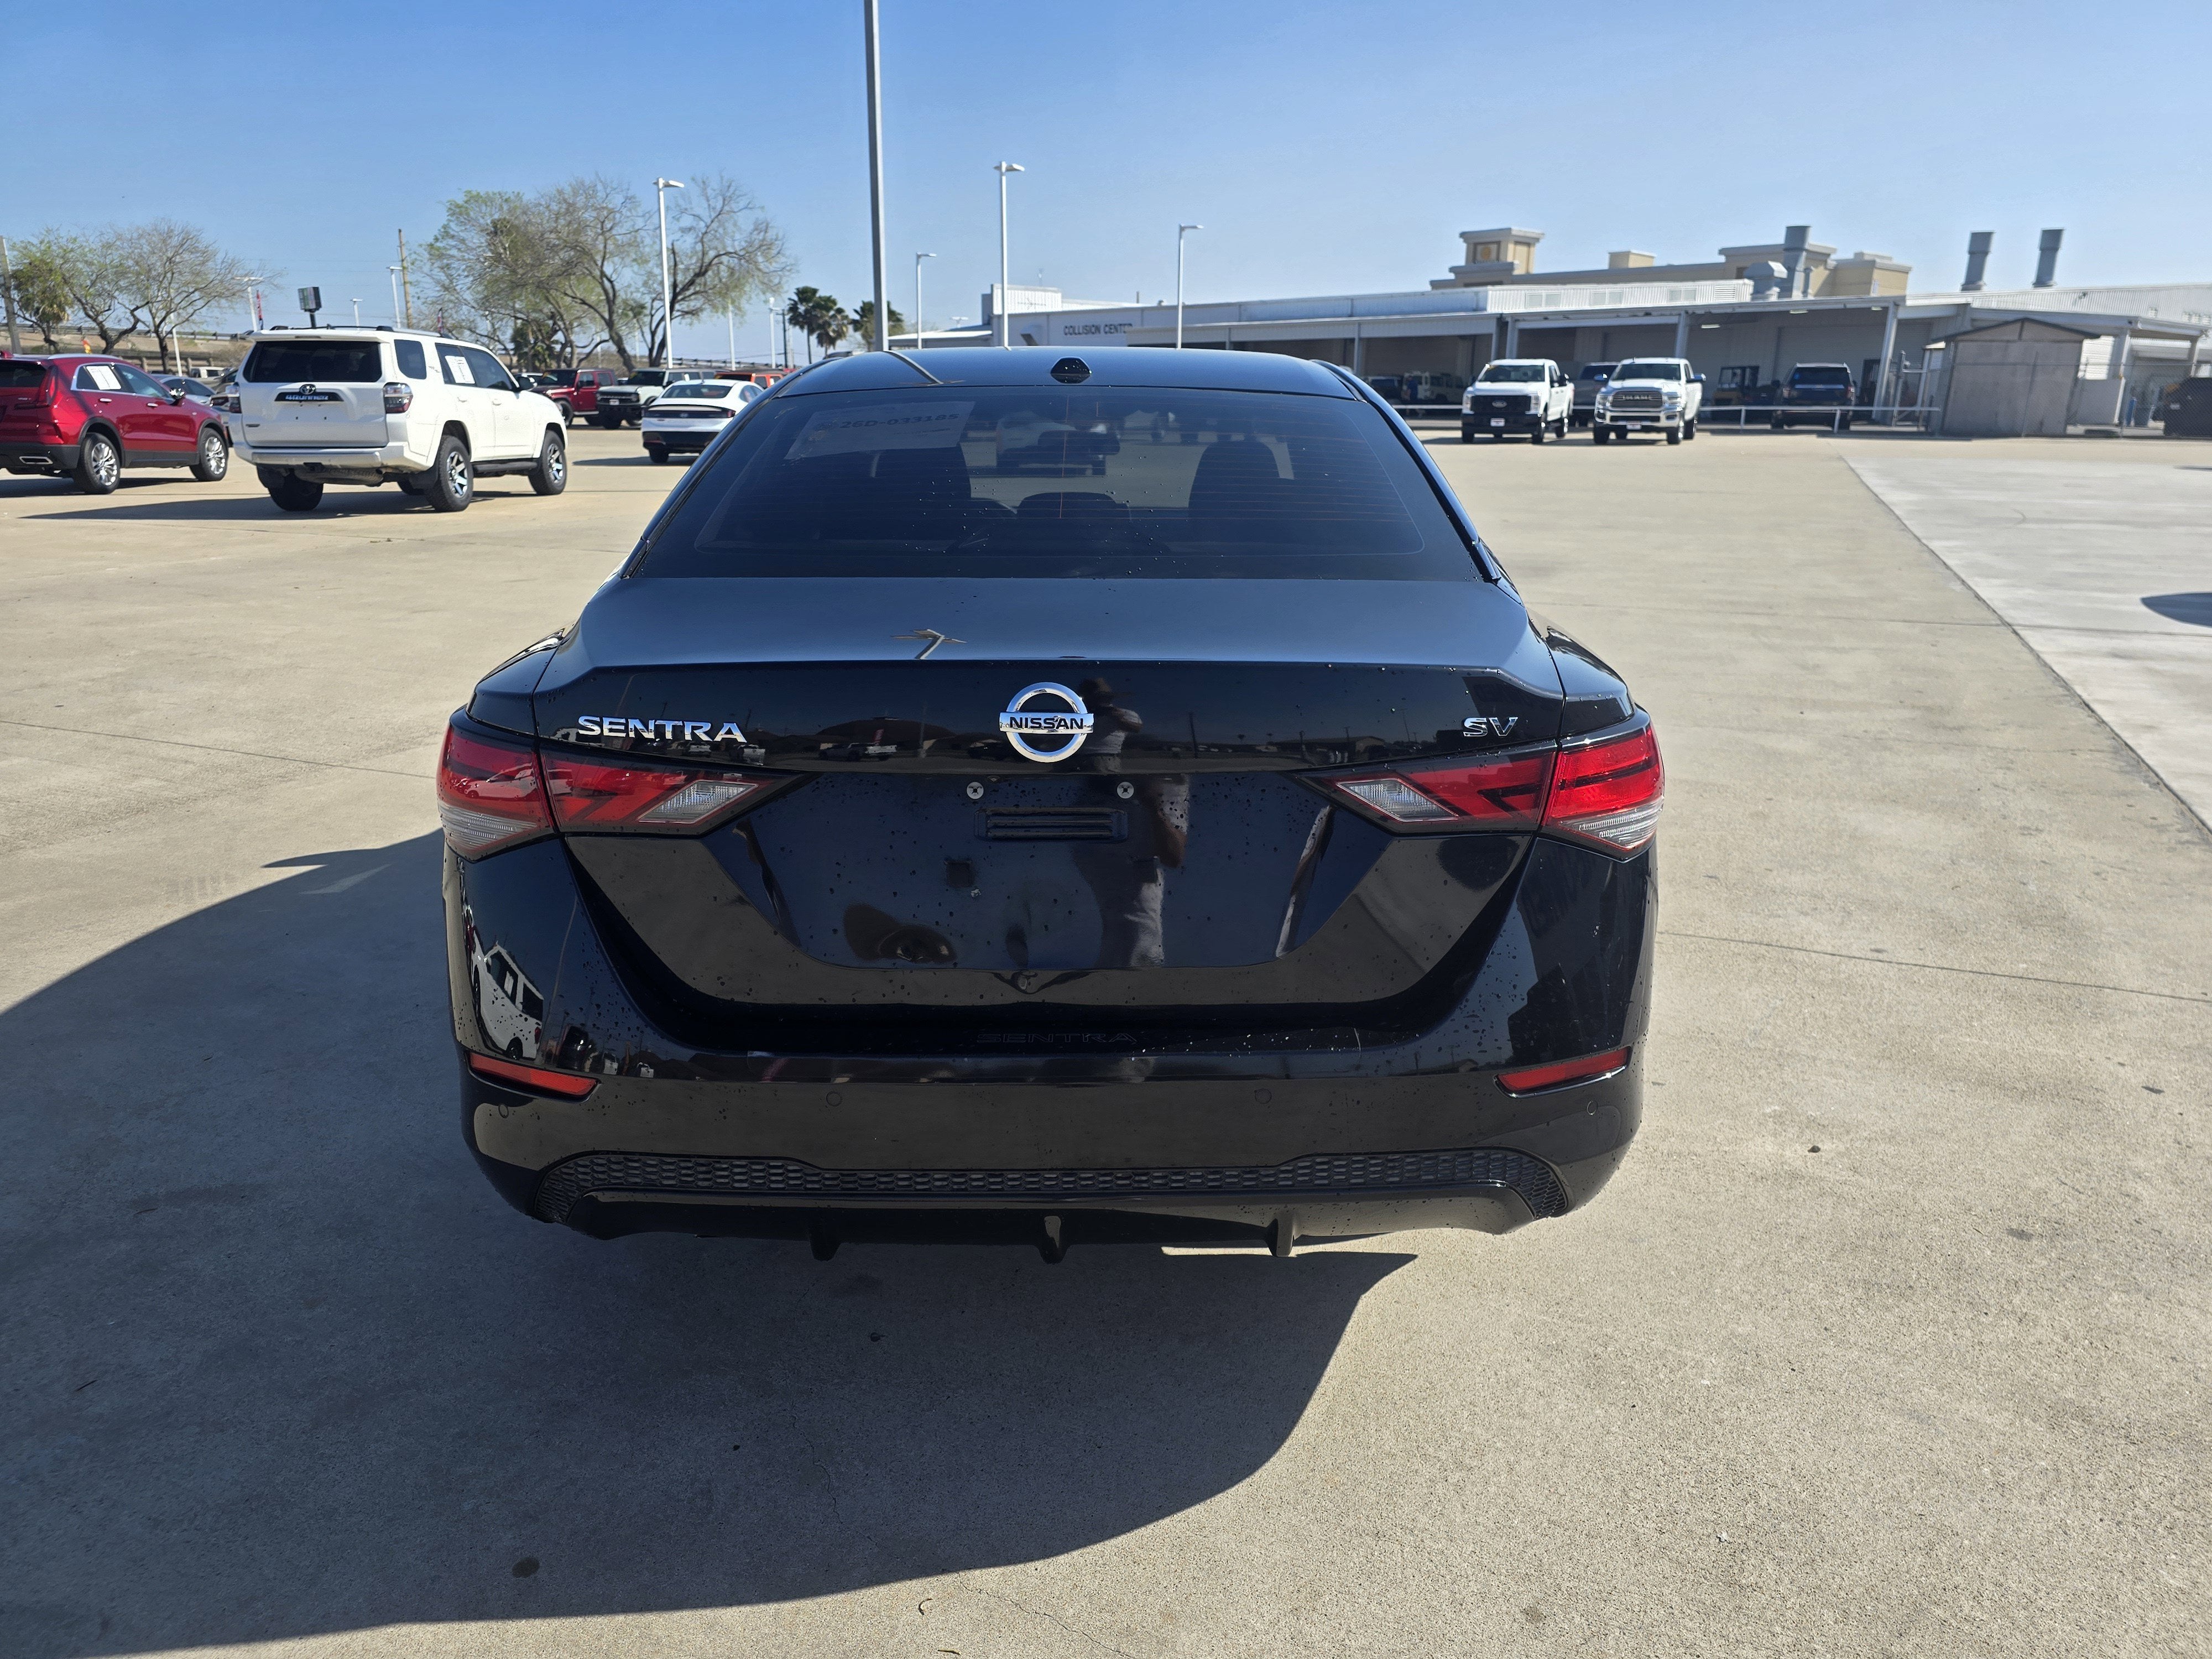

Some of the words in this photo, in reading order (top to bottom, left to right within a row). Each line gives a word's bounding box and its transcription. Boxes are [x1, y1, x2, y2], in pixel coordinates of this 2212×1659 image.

[1064, 325, 1101, 335] COLLISION
[1104, 323, 1133, 335] CENTE
[578, 715, 747, 743] SENTRA
[1010, 717, 1084, 730] NISSAN
[1463, 717, 1519, 737] SV
[977, 1032, 1137, 1044] SENTRA
